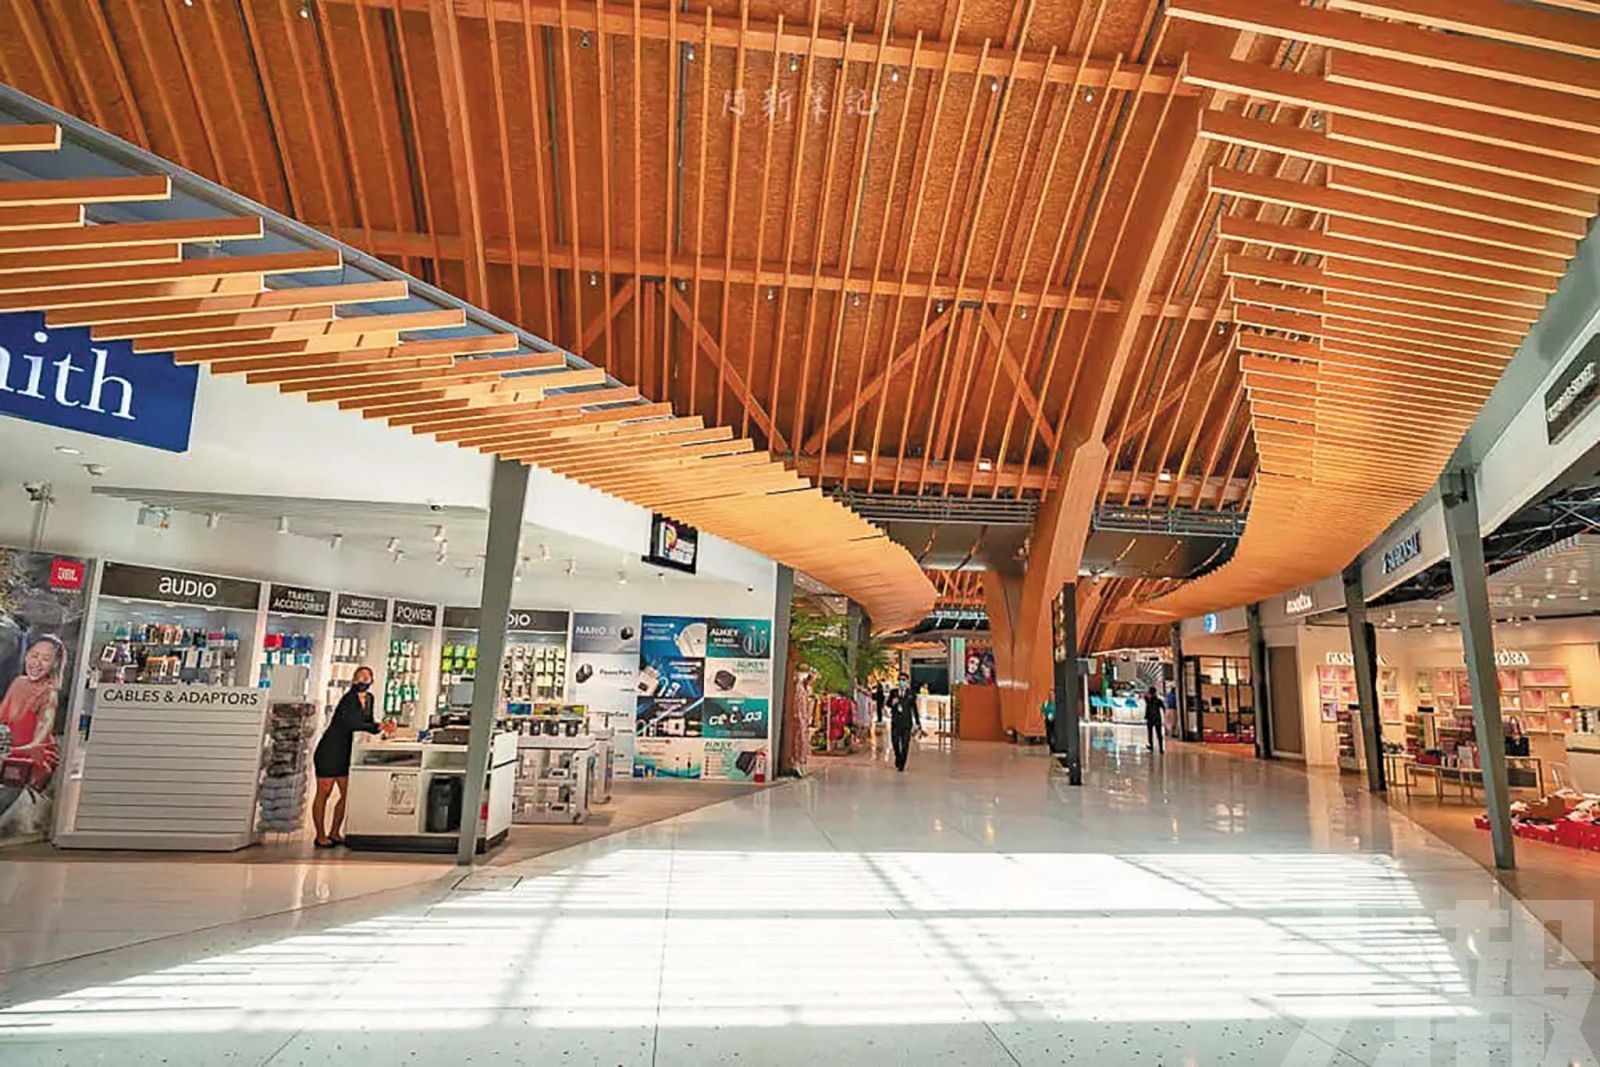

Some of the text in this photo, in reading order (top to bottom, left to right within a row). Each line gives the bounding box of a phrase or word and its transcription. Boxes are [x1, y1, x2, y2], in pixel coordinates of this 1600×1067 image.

[396, 606, 433, 621] POWER
[104, 689, 259, 706] CABLES & ADAPTORS
